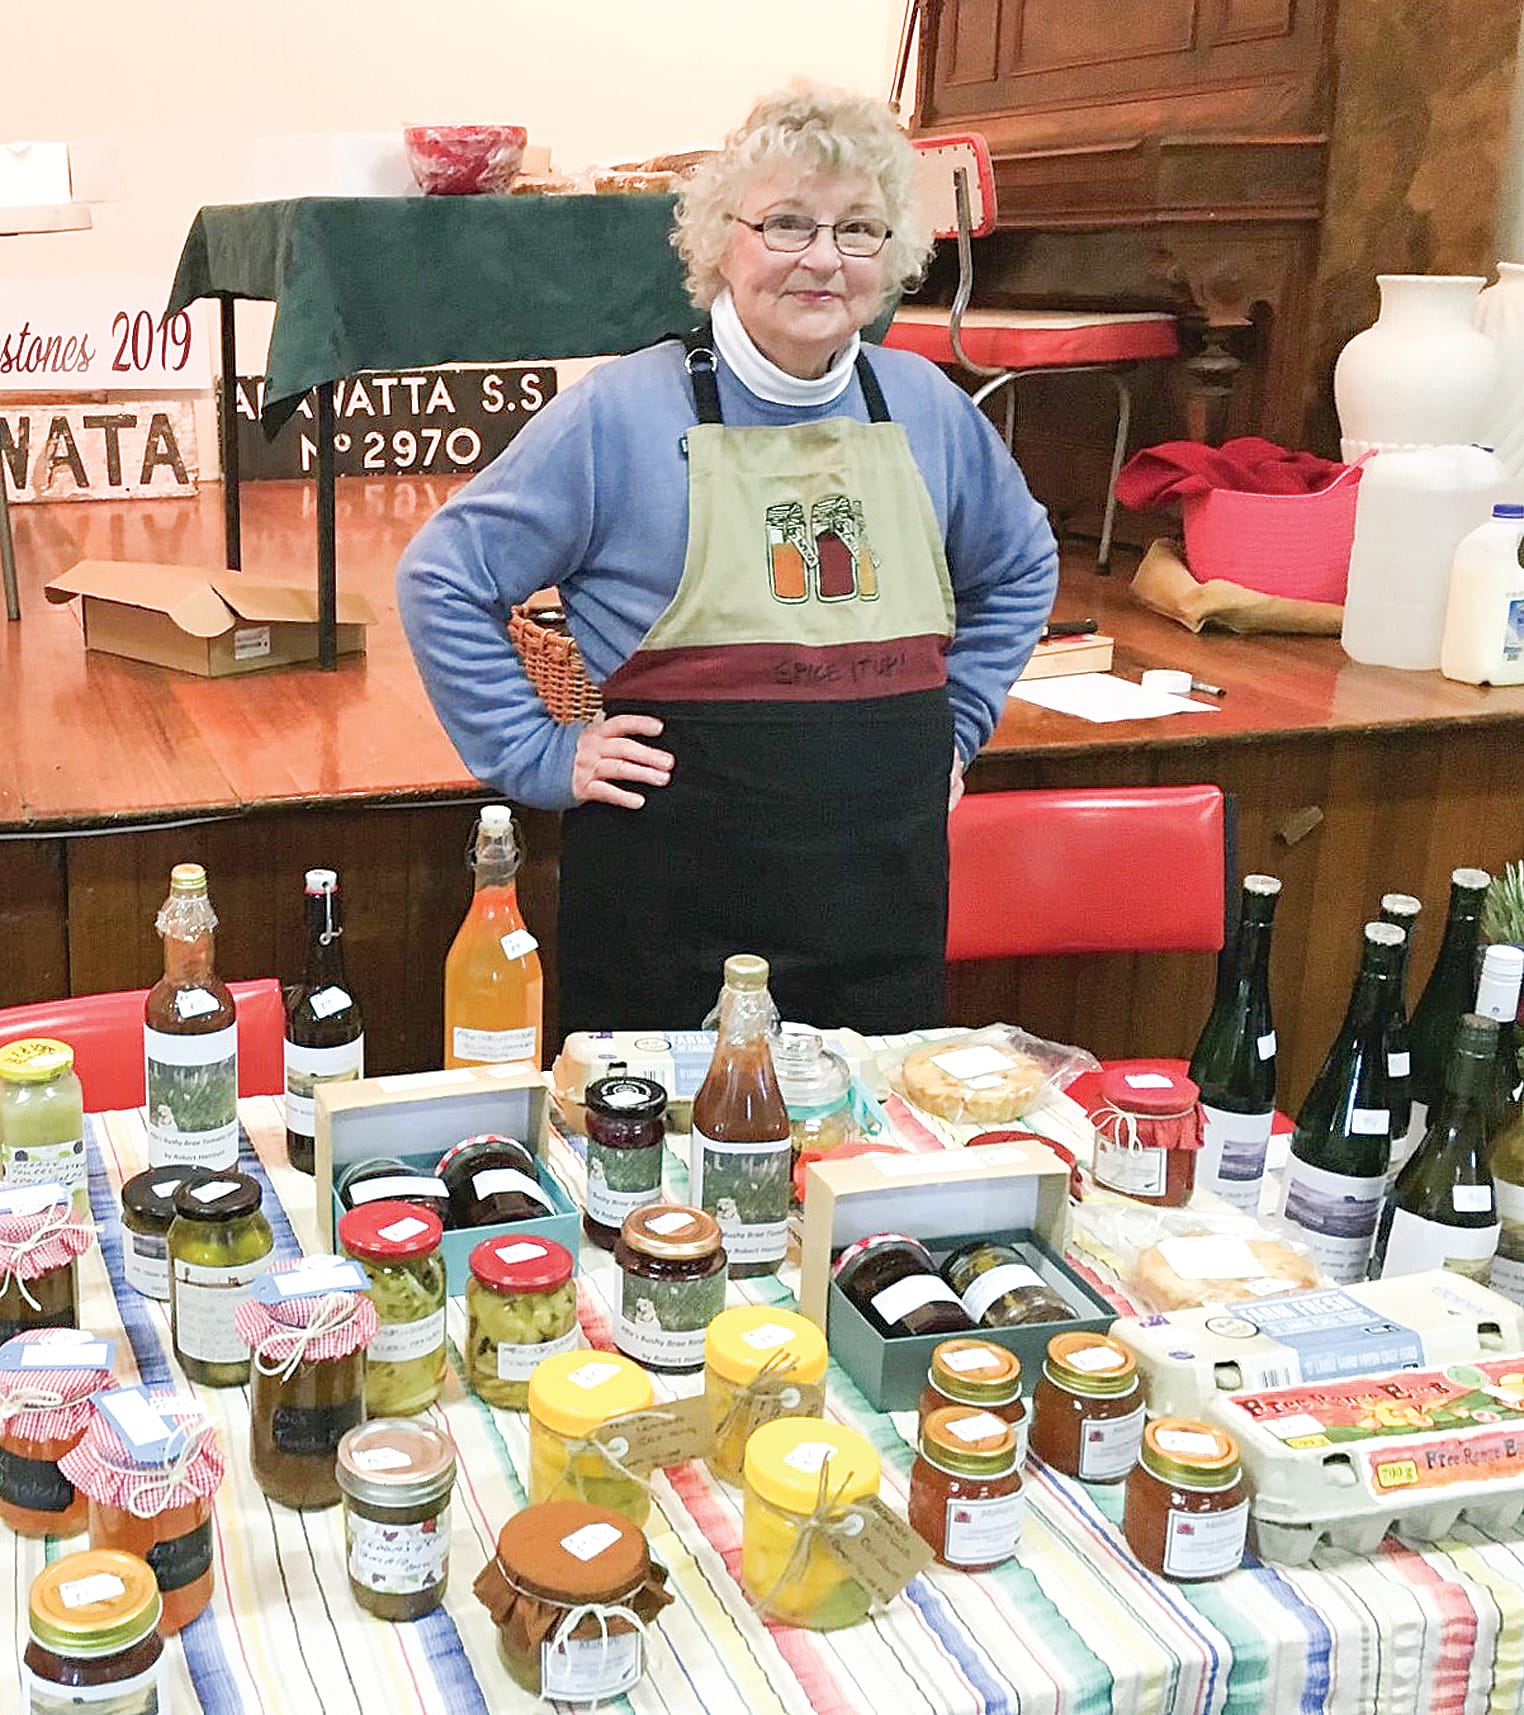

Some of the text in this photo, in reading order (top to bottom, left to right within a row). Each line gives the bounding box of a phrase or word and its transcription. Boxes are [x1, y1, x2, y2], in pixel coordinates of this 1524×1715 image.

[112, 310, 192, 372] 2019
[363, 427, 482, 470] 2970
[1237, 1295, 1356, 1323] FARM FRESH
[1381, 1466, 1403, 1481] 700
